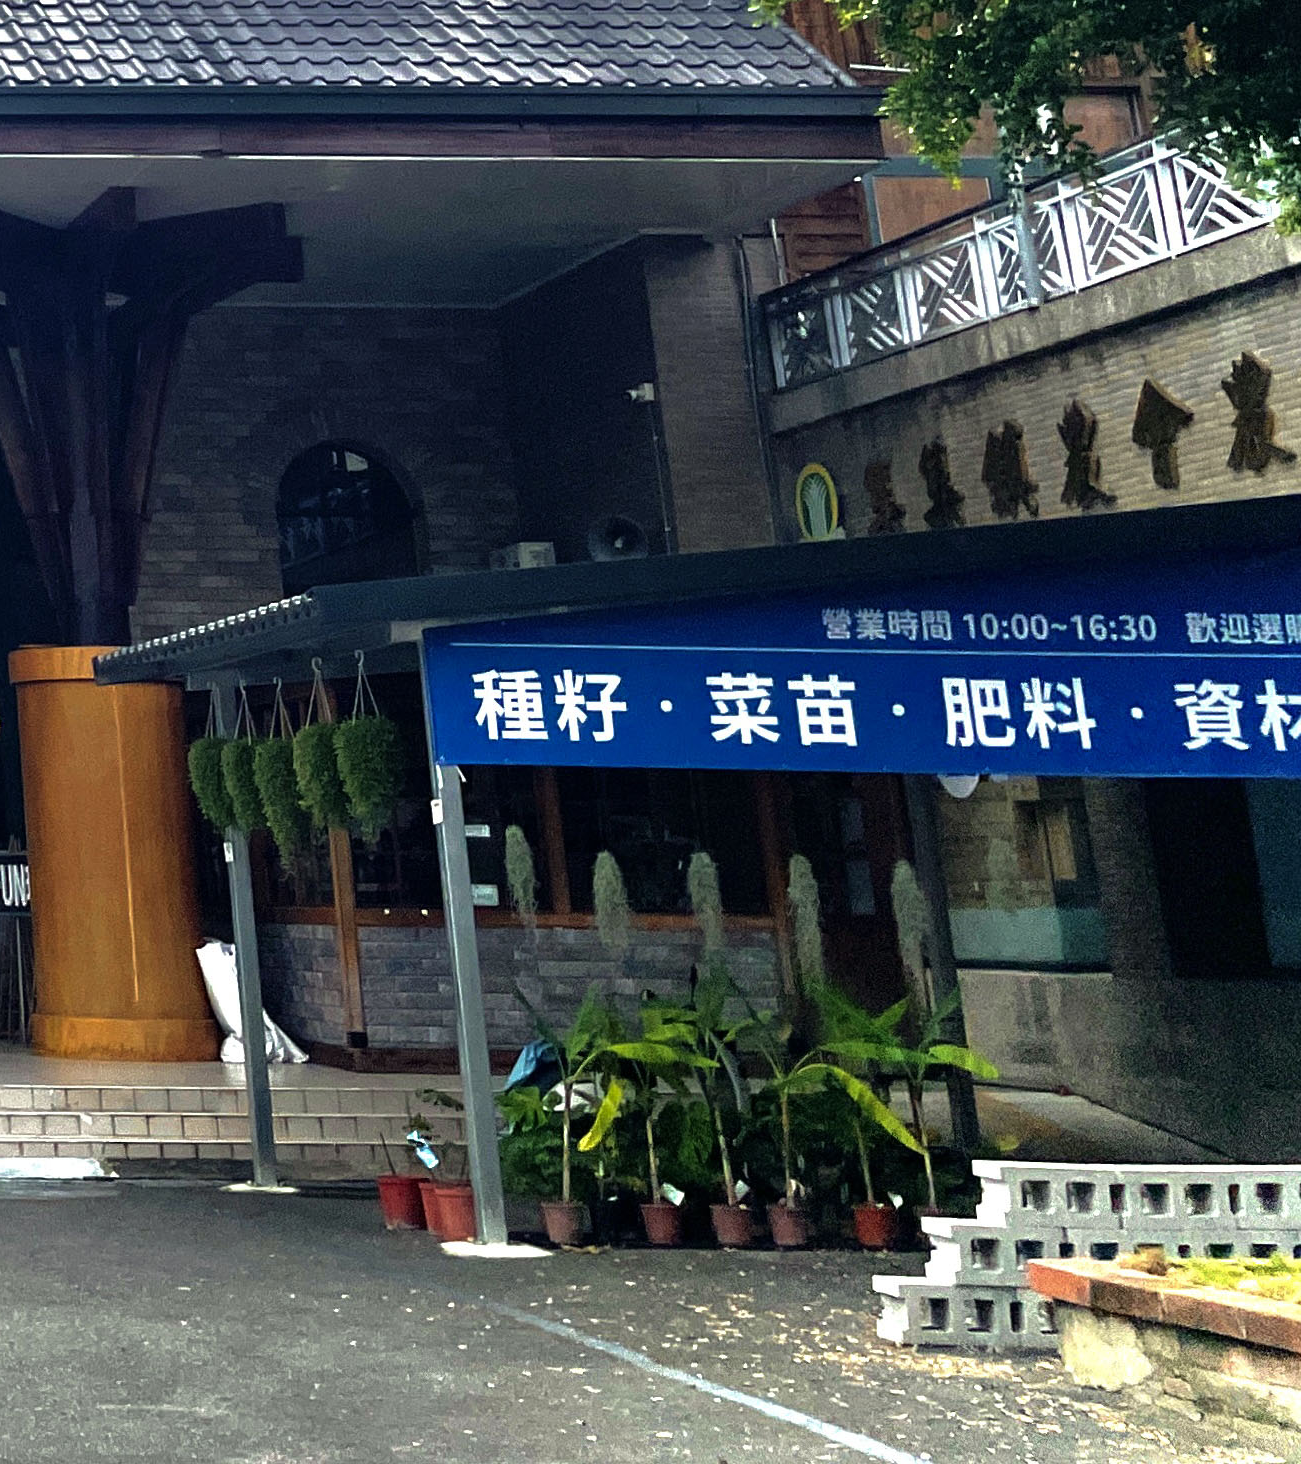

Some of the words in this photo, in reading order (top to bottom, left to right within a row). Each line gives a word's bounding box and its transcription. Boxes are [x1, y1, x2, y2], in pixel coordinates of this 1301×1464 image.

[821, 607, 952, 641] 營業時間
[963, 613, 1157, 642] 10:00~16:30
